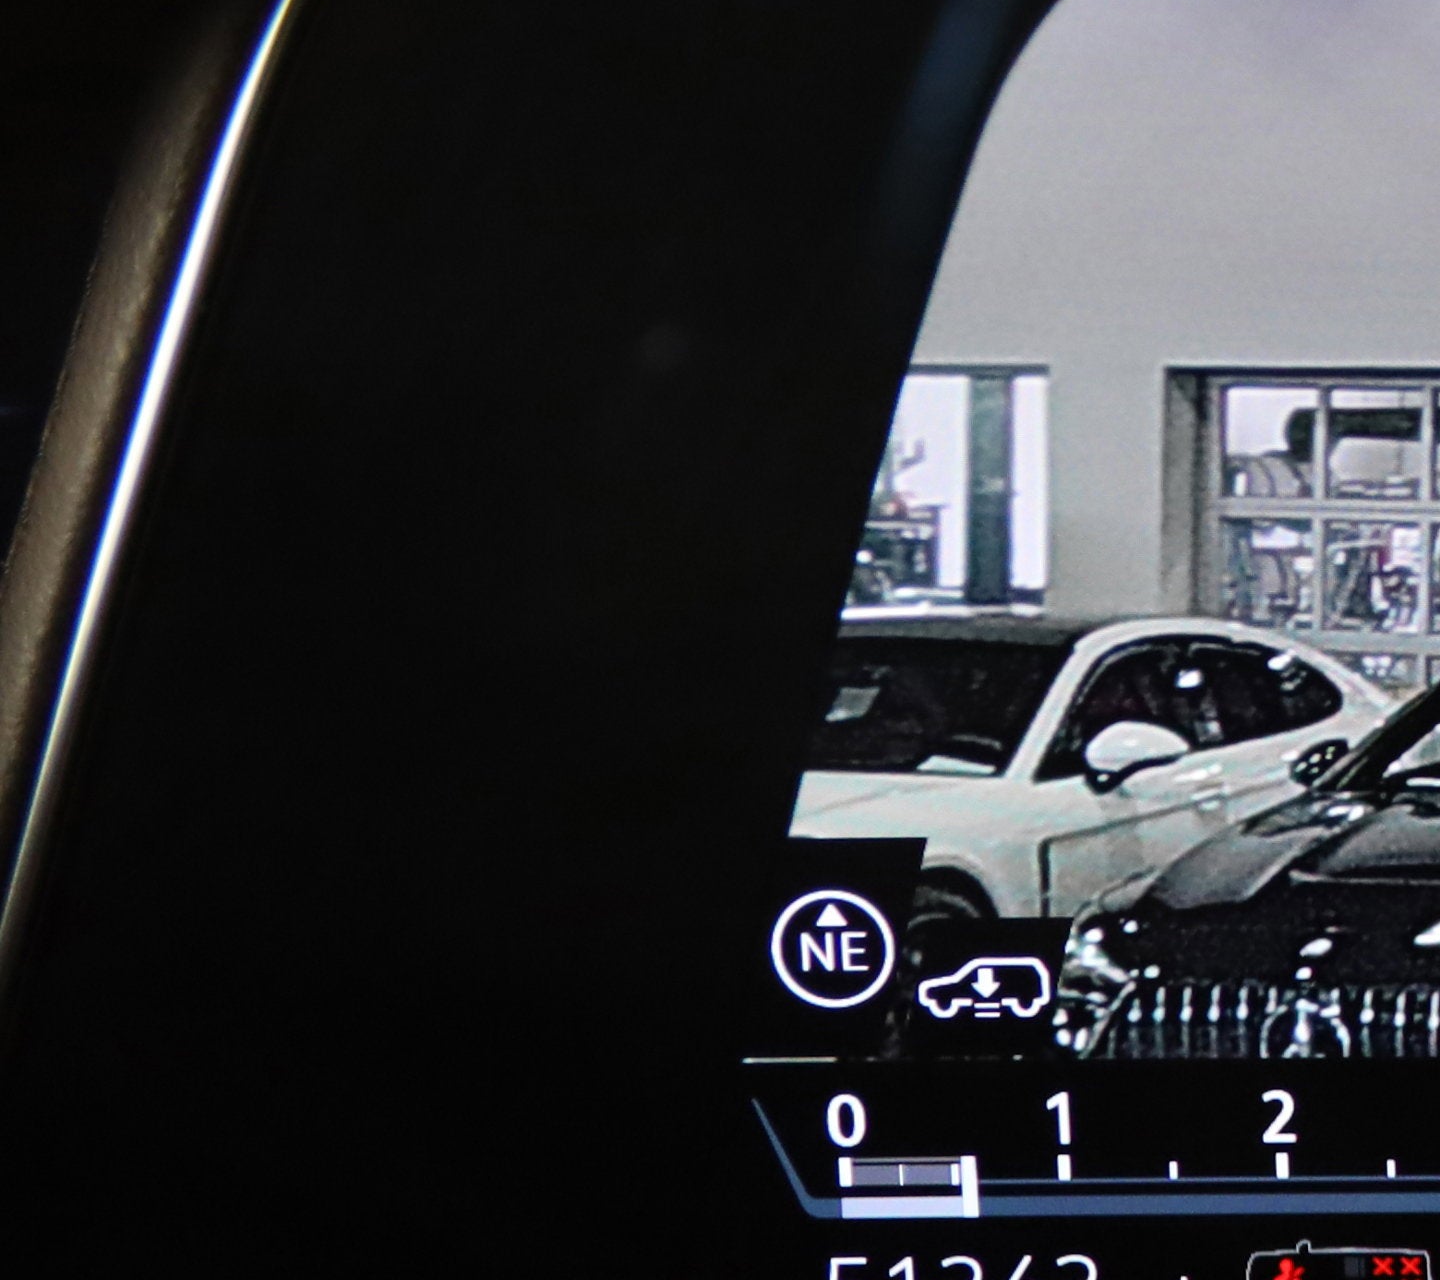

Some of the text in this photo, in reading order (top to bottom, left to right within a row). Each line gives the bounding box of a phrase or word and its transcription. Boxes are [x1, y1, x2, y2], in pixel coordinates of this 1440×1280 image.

[799, 930, 869, 973] NE
[827, 1094, 866, 1147] 0
[1046, 1092, 1071, 1145] 1
[1262, 1090, 1297, 1143] 2
